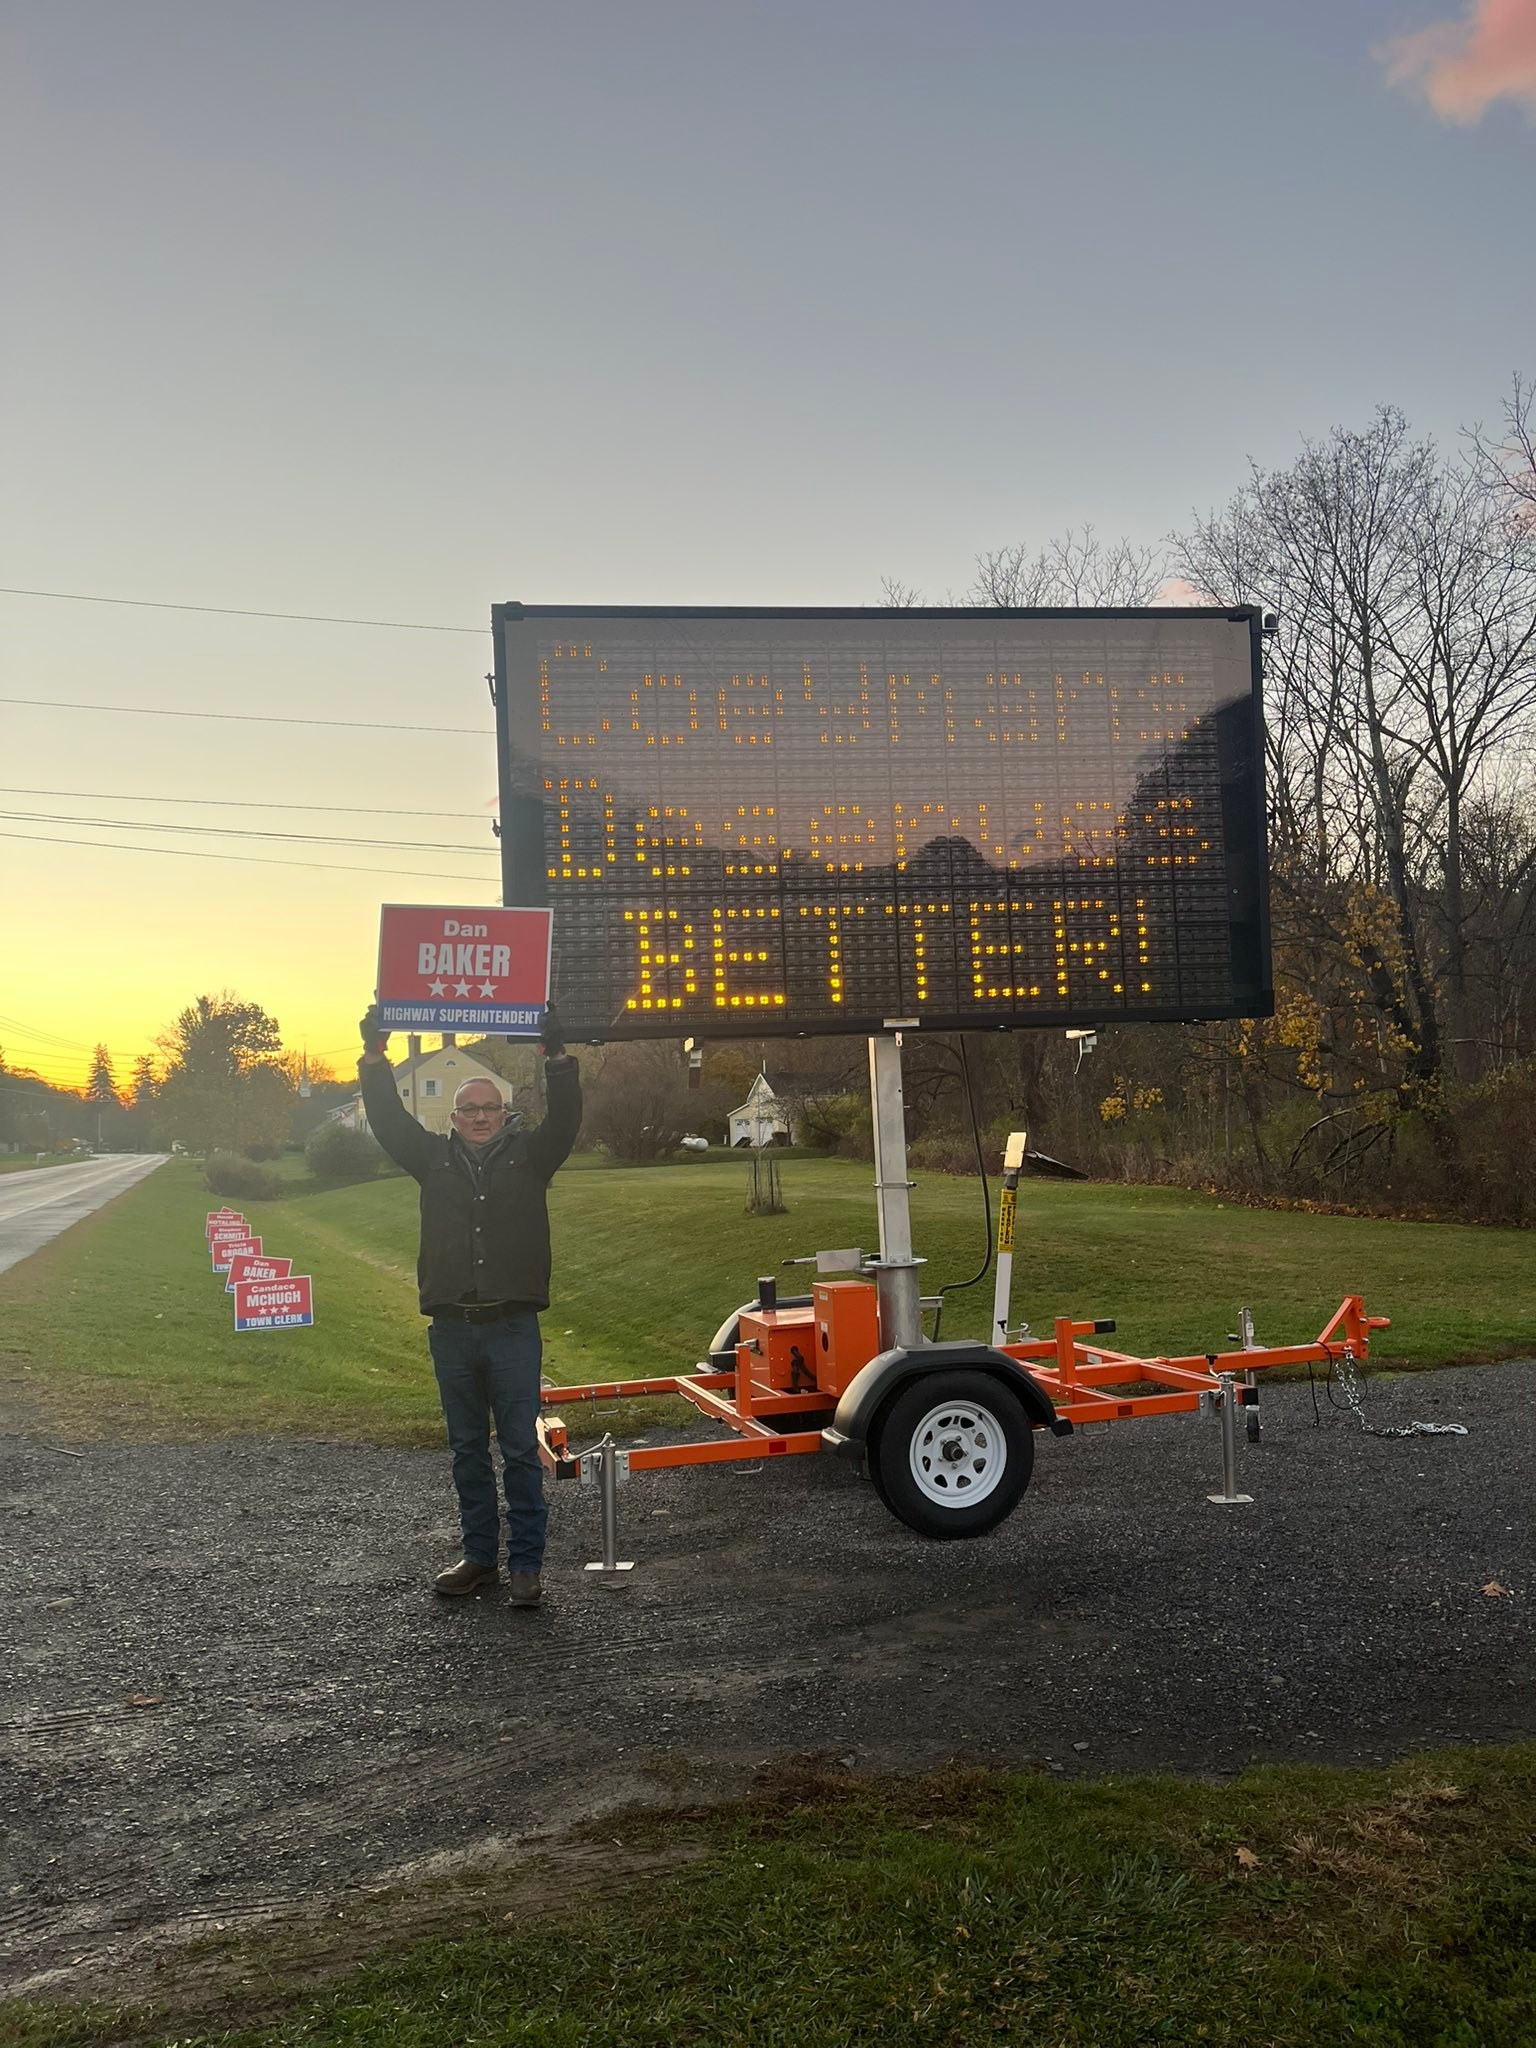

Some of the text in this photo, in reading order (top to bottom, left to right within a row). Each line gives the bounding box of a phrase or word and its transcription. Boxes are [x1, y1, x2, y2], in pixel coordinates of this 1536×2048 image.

[540, 644, 1201, 744] Coeymans
[544, 778, 1210, 878] Deserves
[444, 920, 488, 937] Dan
[417, 942, 511, 977] BAKER
[624, 897, 1154, 1010] BETTER!
[383, 1006, 540, 1025] HIGHWAY SUPERINTENDENT
[214, 1232, 246, 1240] SCHMITT
[221, 1247, 253, 1257] GROGAN
[253, 1259, 270, 1267] Dan
[243, 1266, 276, 1279] BAKER
[251, 1284, 295, 1293] Candace
[246, 1291, 301, 1307] MCHUGH
[245, 1313, 303, 1327] TOWN CLERK
